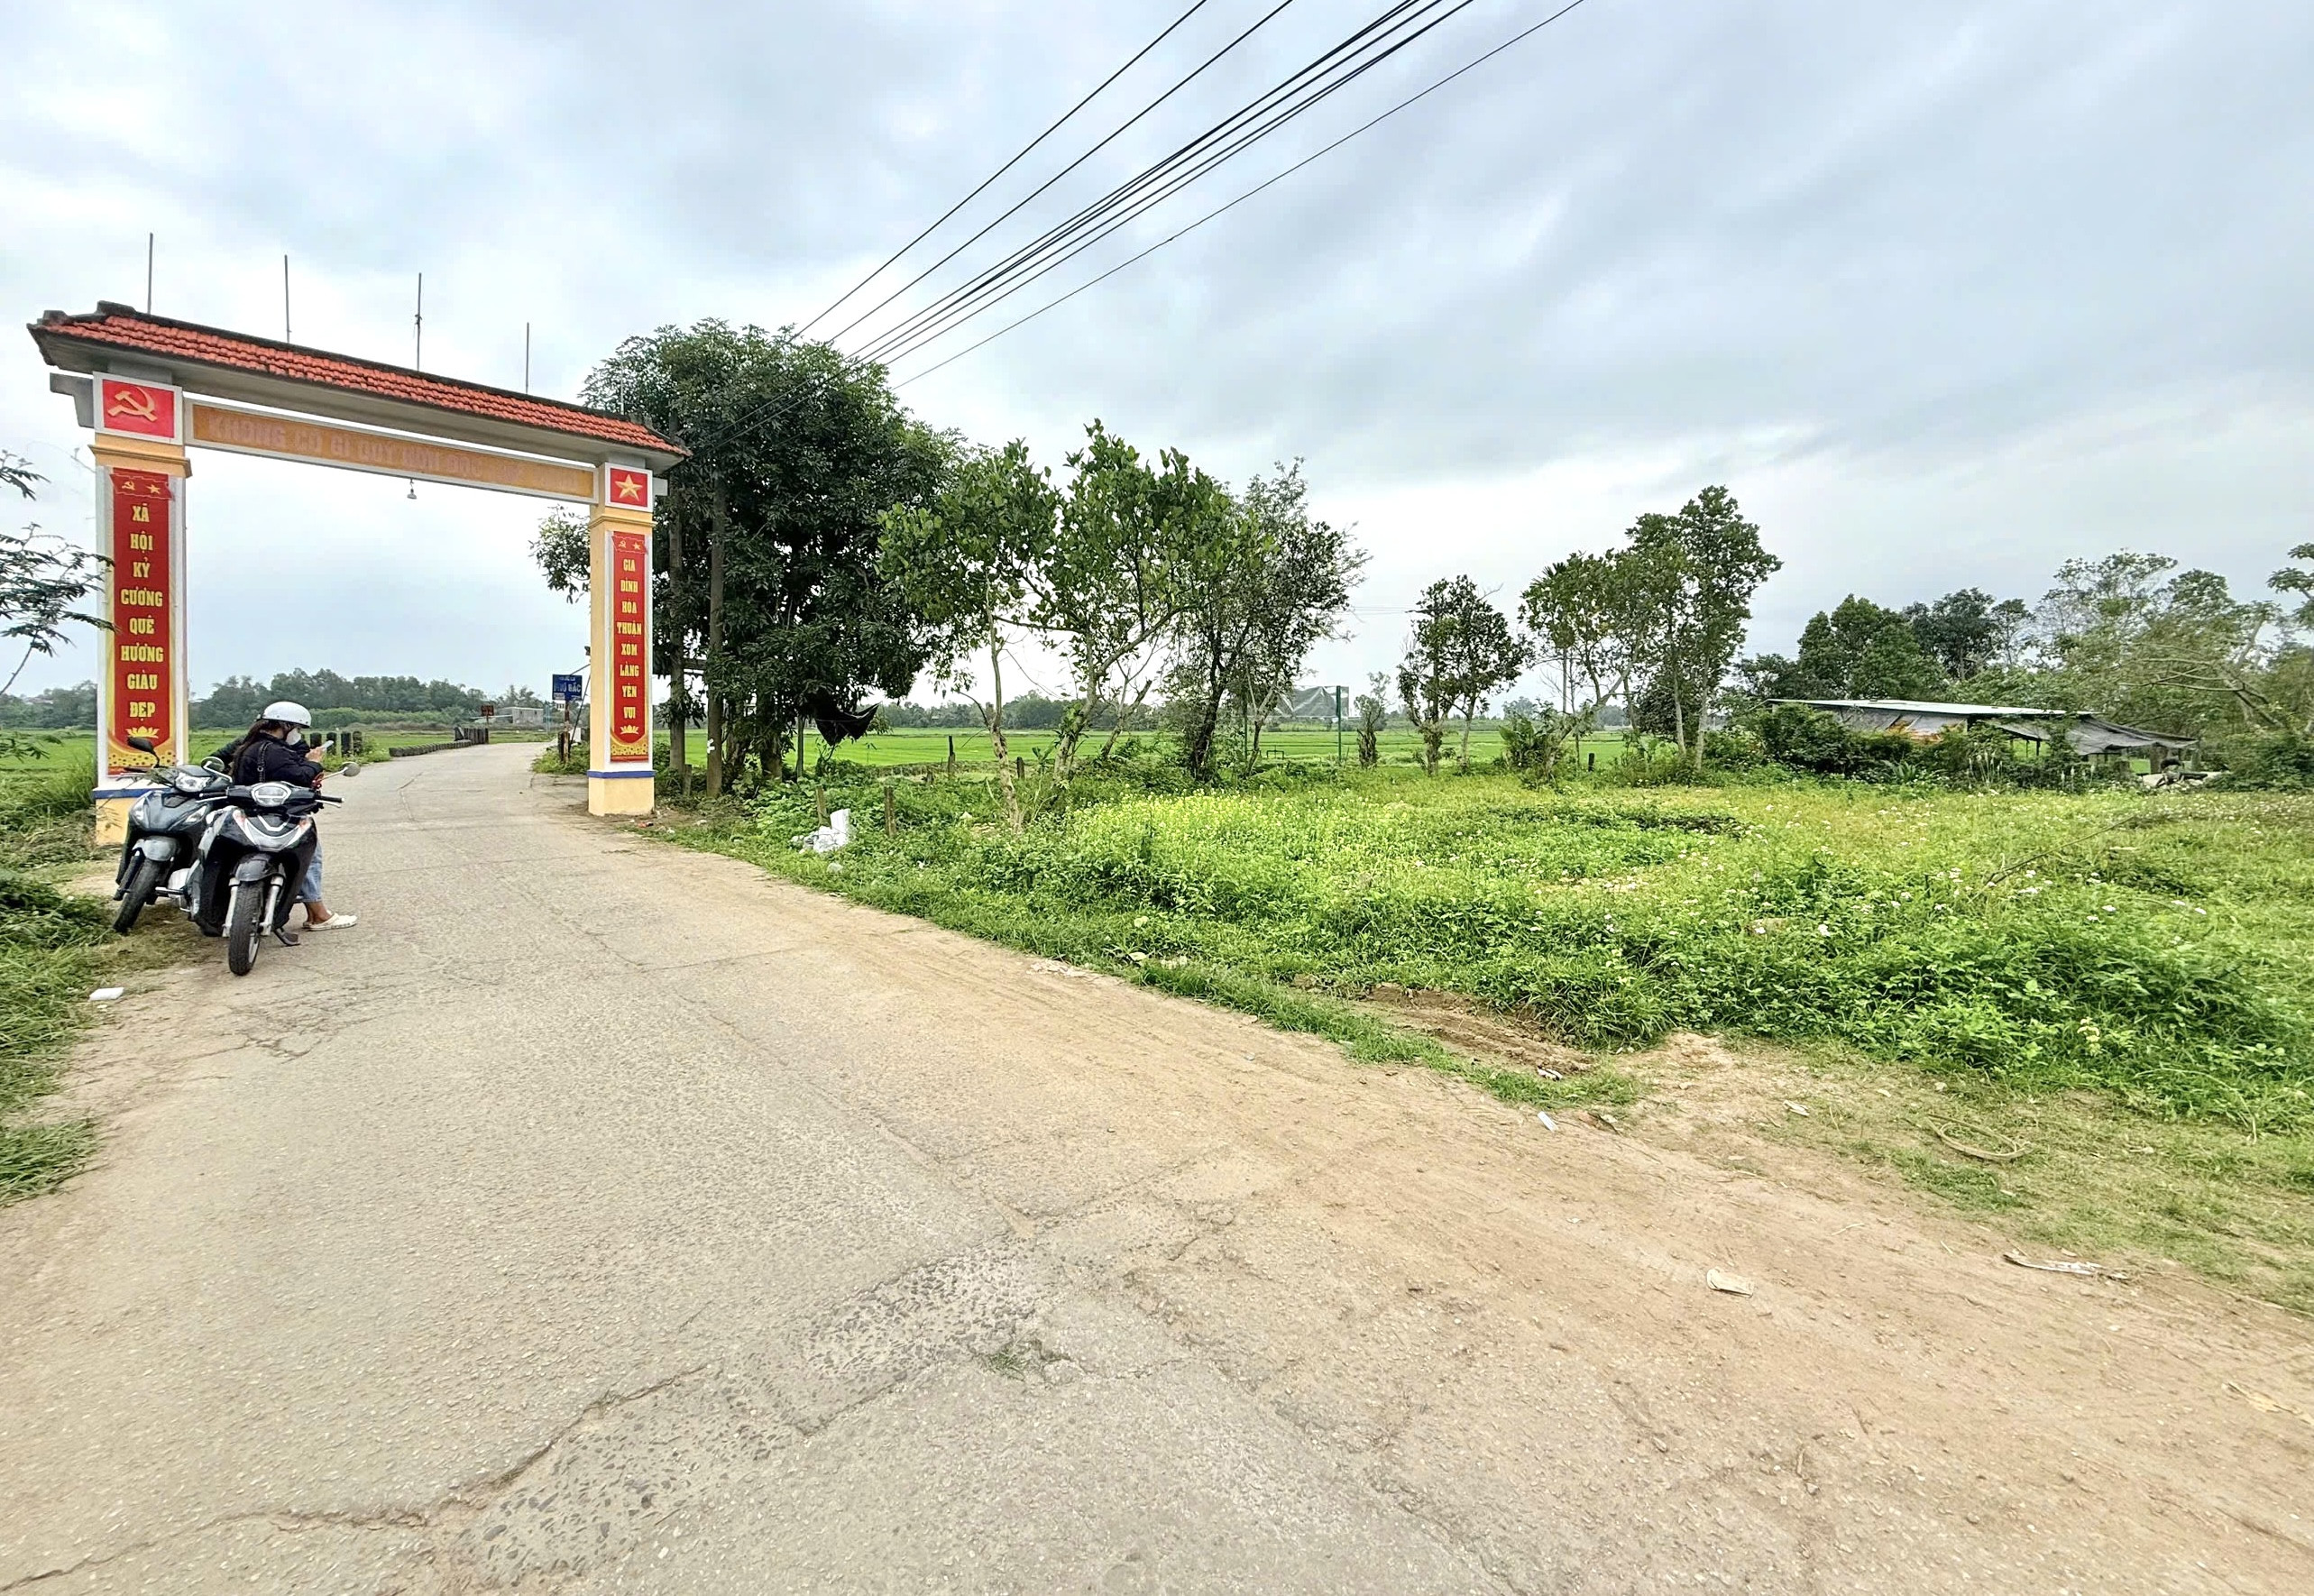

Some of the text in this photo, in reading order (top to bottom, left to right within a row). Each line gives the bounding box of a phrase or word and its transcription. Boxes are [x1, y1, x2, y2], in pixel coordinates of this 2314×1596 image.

[132, 502, 150, 522] XÃ
[130, 530, 153, 554] HỘI
[133, 556, 151, 578] KỶ
[622, 558, 636, 572] GIA
[620, 577, 638, 593] ĐÌNH
[120, 586, 163, 607] CƯƠNG
[621, 598, 638, 614] HÒA
[129, 614, 154, 635] QUÊ
[616, 619, 642, 637] THUẬN
[120, 642, 164, 663] HƯƠNG
[620, 640, 638, 656] XÓM
[620, 661, 639, 677] LÀNG
[127, 669, 158, 690] GIÀU
[621, 683, 638, 698] YÊN
[129, 702, 156, 721] ĐẸP
[623, 706, 636, 719] VUI
